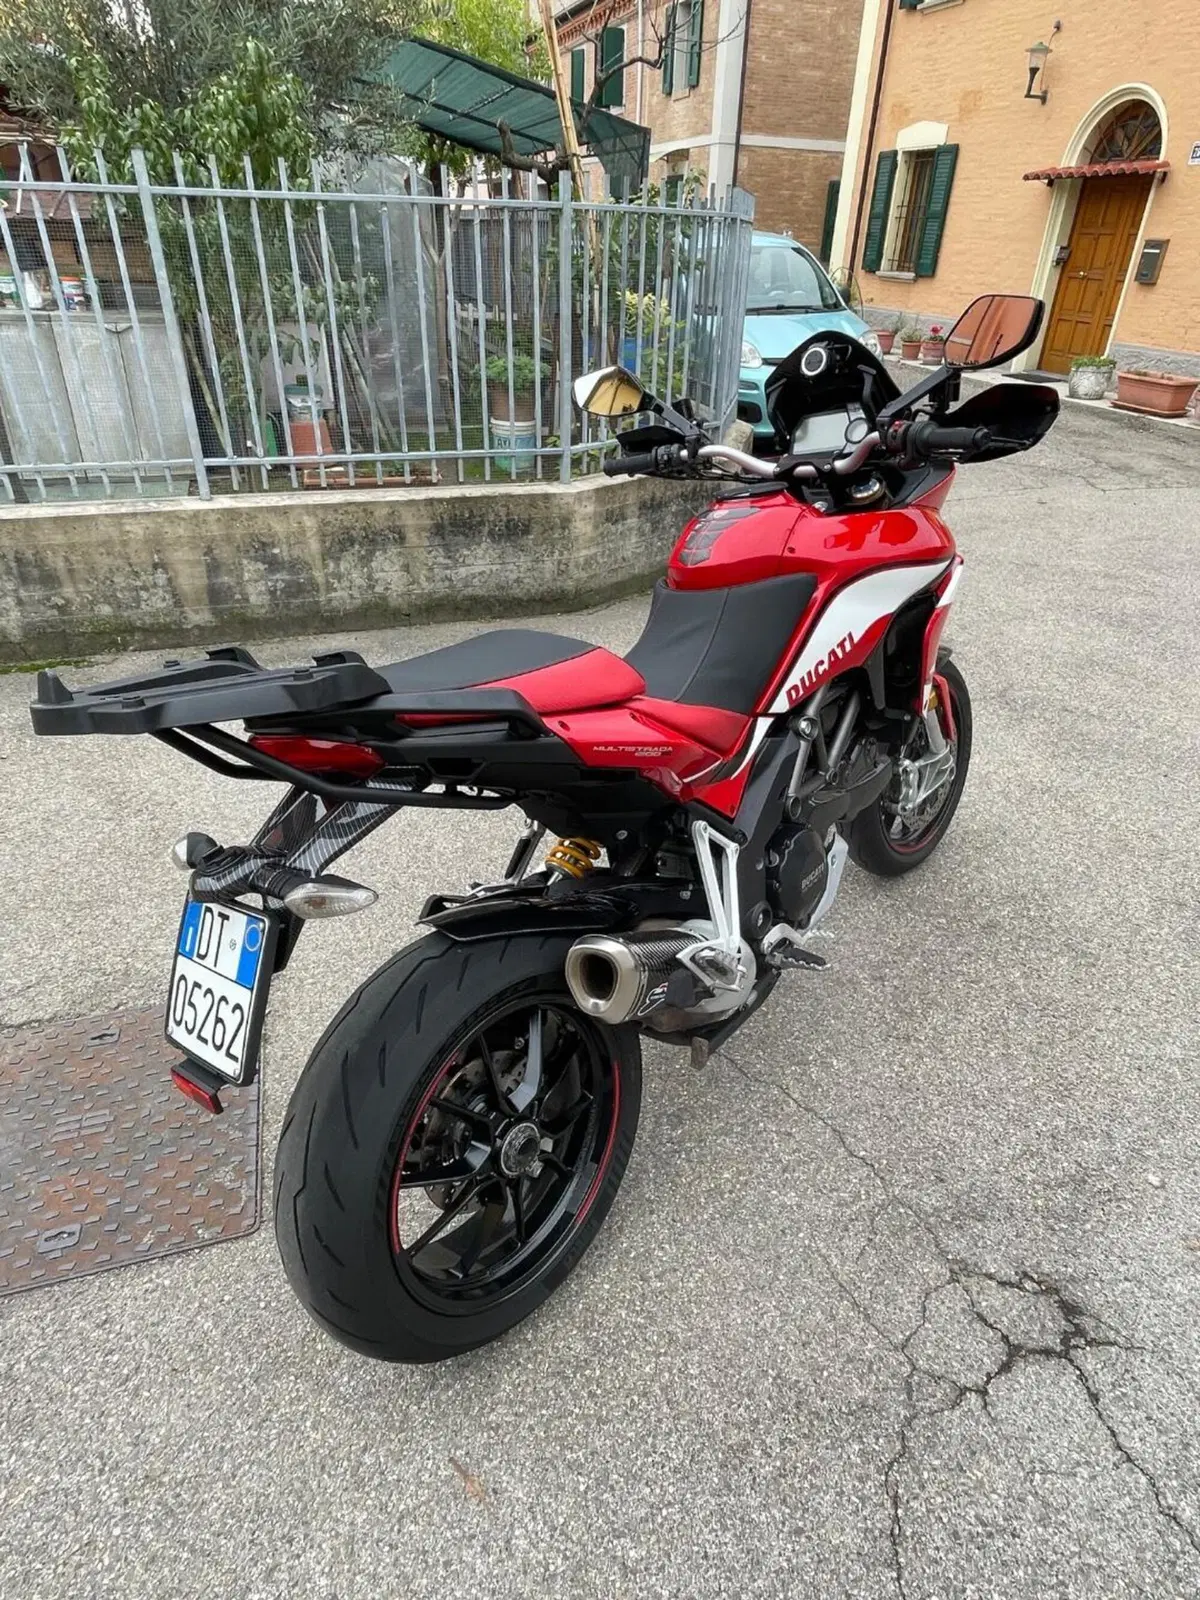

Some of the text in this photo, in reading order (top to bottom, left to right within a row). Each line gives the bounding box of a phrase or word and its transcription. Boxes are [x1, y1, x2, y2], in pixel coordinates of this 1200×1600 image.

[785, 631, 856, 709] DUCATI
[196, 905, 230, 968] DT
[173, 974, 245, 1063] 05262
